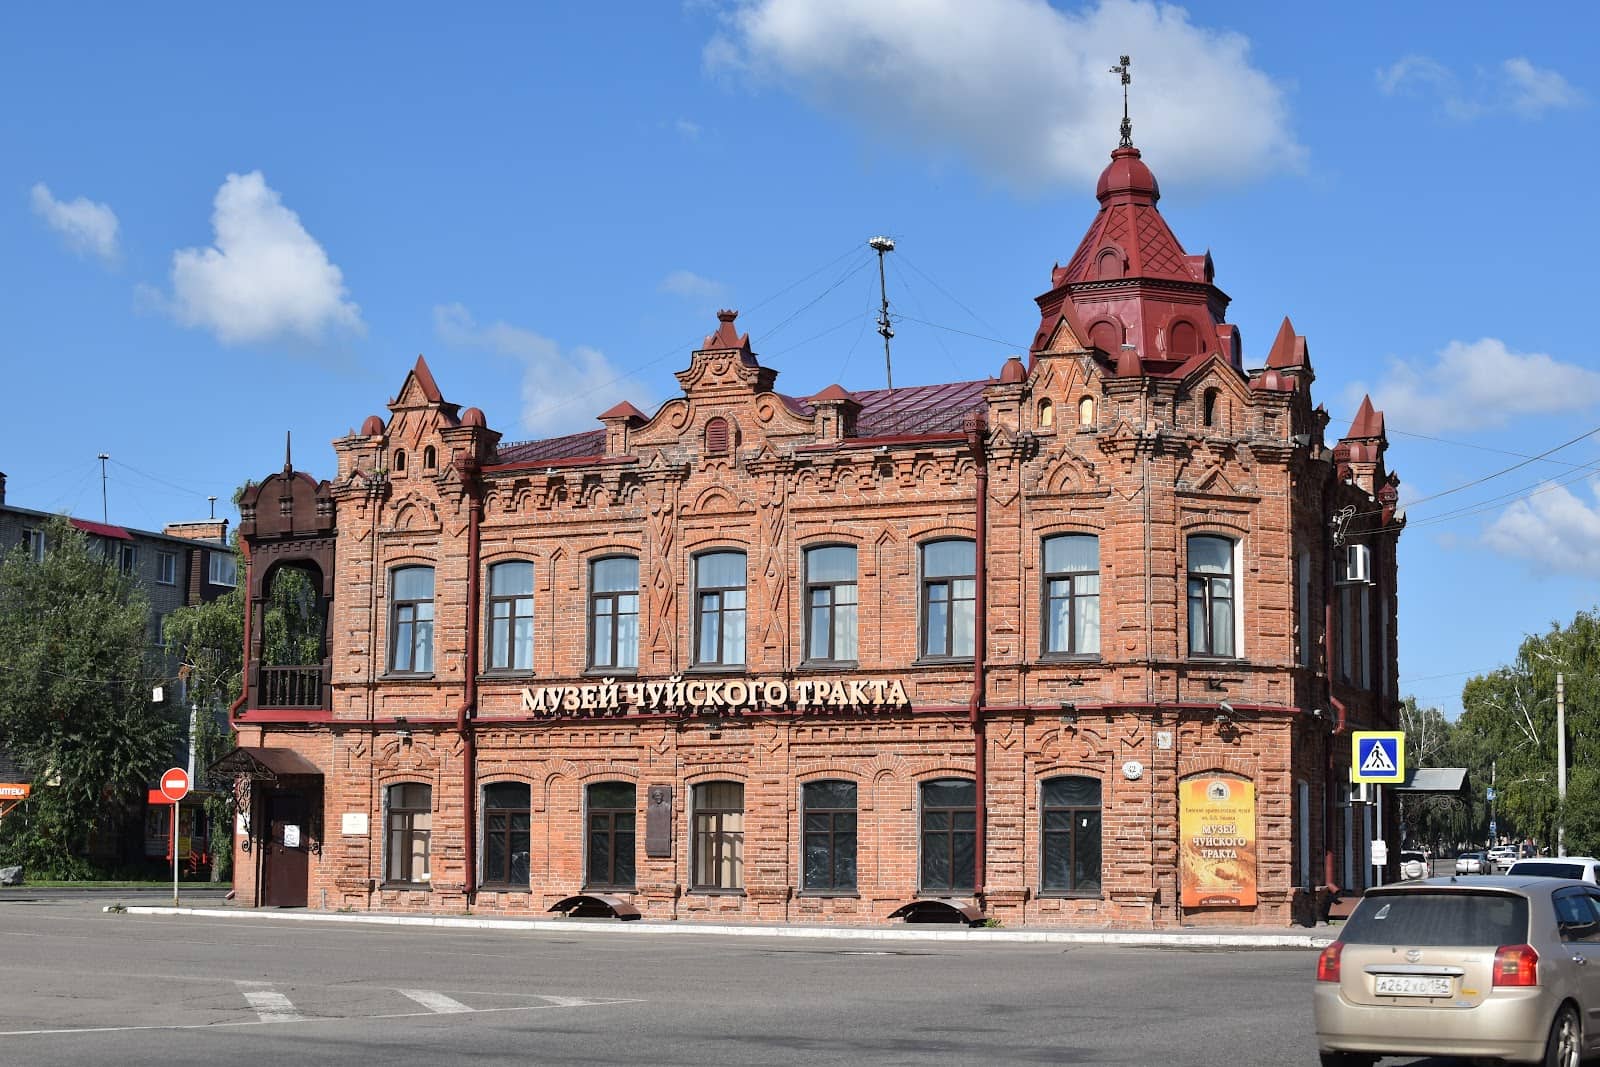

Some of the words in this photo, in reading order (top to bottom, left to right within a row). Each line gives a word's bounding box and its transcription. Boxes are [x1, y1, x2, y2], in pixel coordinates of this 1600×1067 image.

[520, 676, 619, 713] МУЗЕЙ
[626, 675, 788, 709] ЧУЙСКОГО
[796, 679, 908, 705] ТРАКТА
[1202, 823, 1236, 834] МУЗЕЙ
[1192, 835, 1247, 847] ЧУЙСКОГО
[1201, 849, 1238, 859] ТРАКТА
